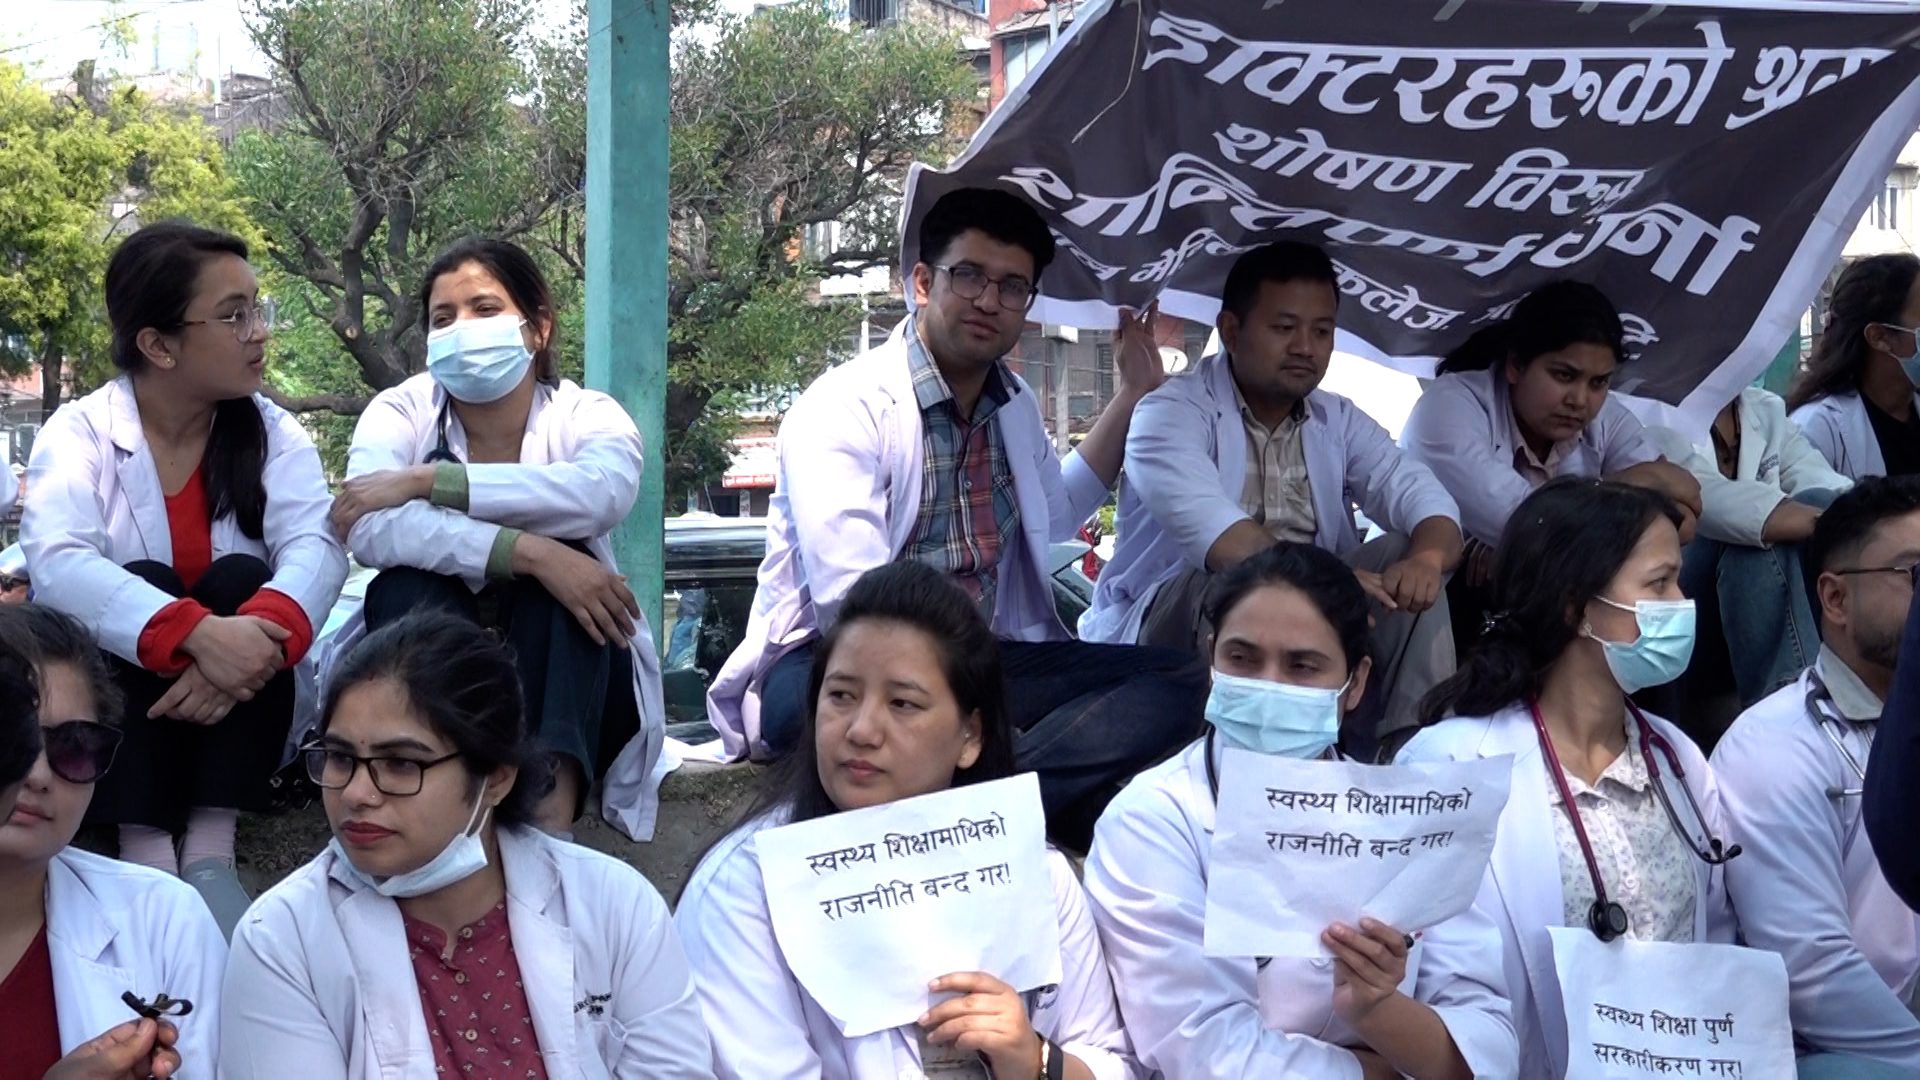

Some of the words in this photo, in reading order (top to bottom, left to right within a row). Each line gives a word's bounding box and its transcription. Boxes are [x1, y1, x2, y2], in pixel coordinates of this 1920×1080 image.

[1212, 123, 1473, 202] शोषण
[1265, 787, 1337, 813] स्वस्थ्य
[805, 843, 876, 875] स्वस्थ्य
[1265, 831, 1362, 857] राजनीति
[1369, 837, 1415, 859] बन्द
[1421, 830, 1454, 849] गर!
[819, 879, 914, 921] राजनीति
[920, 871, 970, 897] बन्द
[976, 862, 1011, 885] गर!
[1650, 1009, 1697, 1037] शिक्षा
[1702, 1012, 1734, 1044] पुर्ण
[1592, 1042, 1701, 1076] सरकारीकरण
